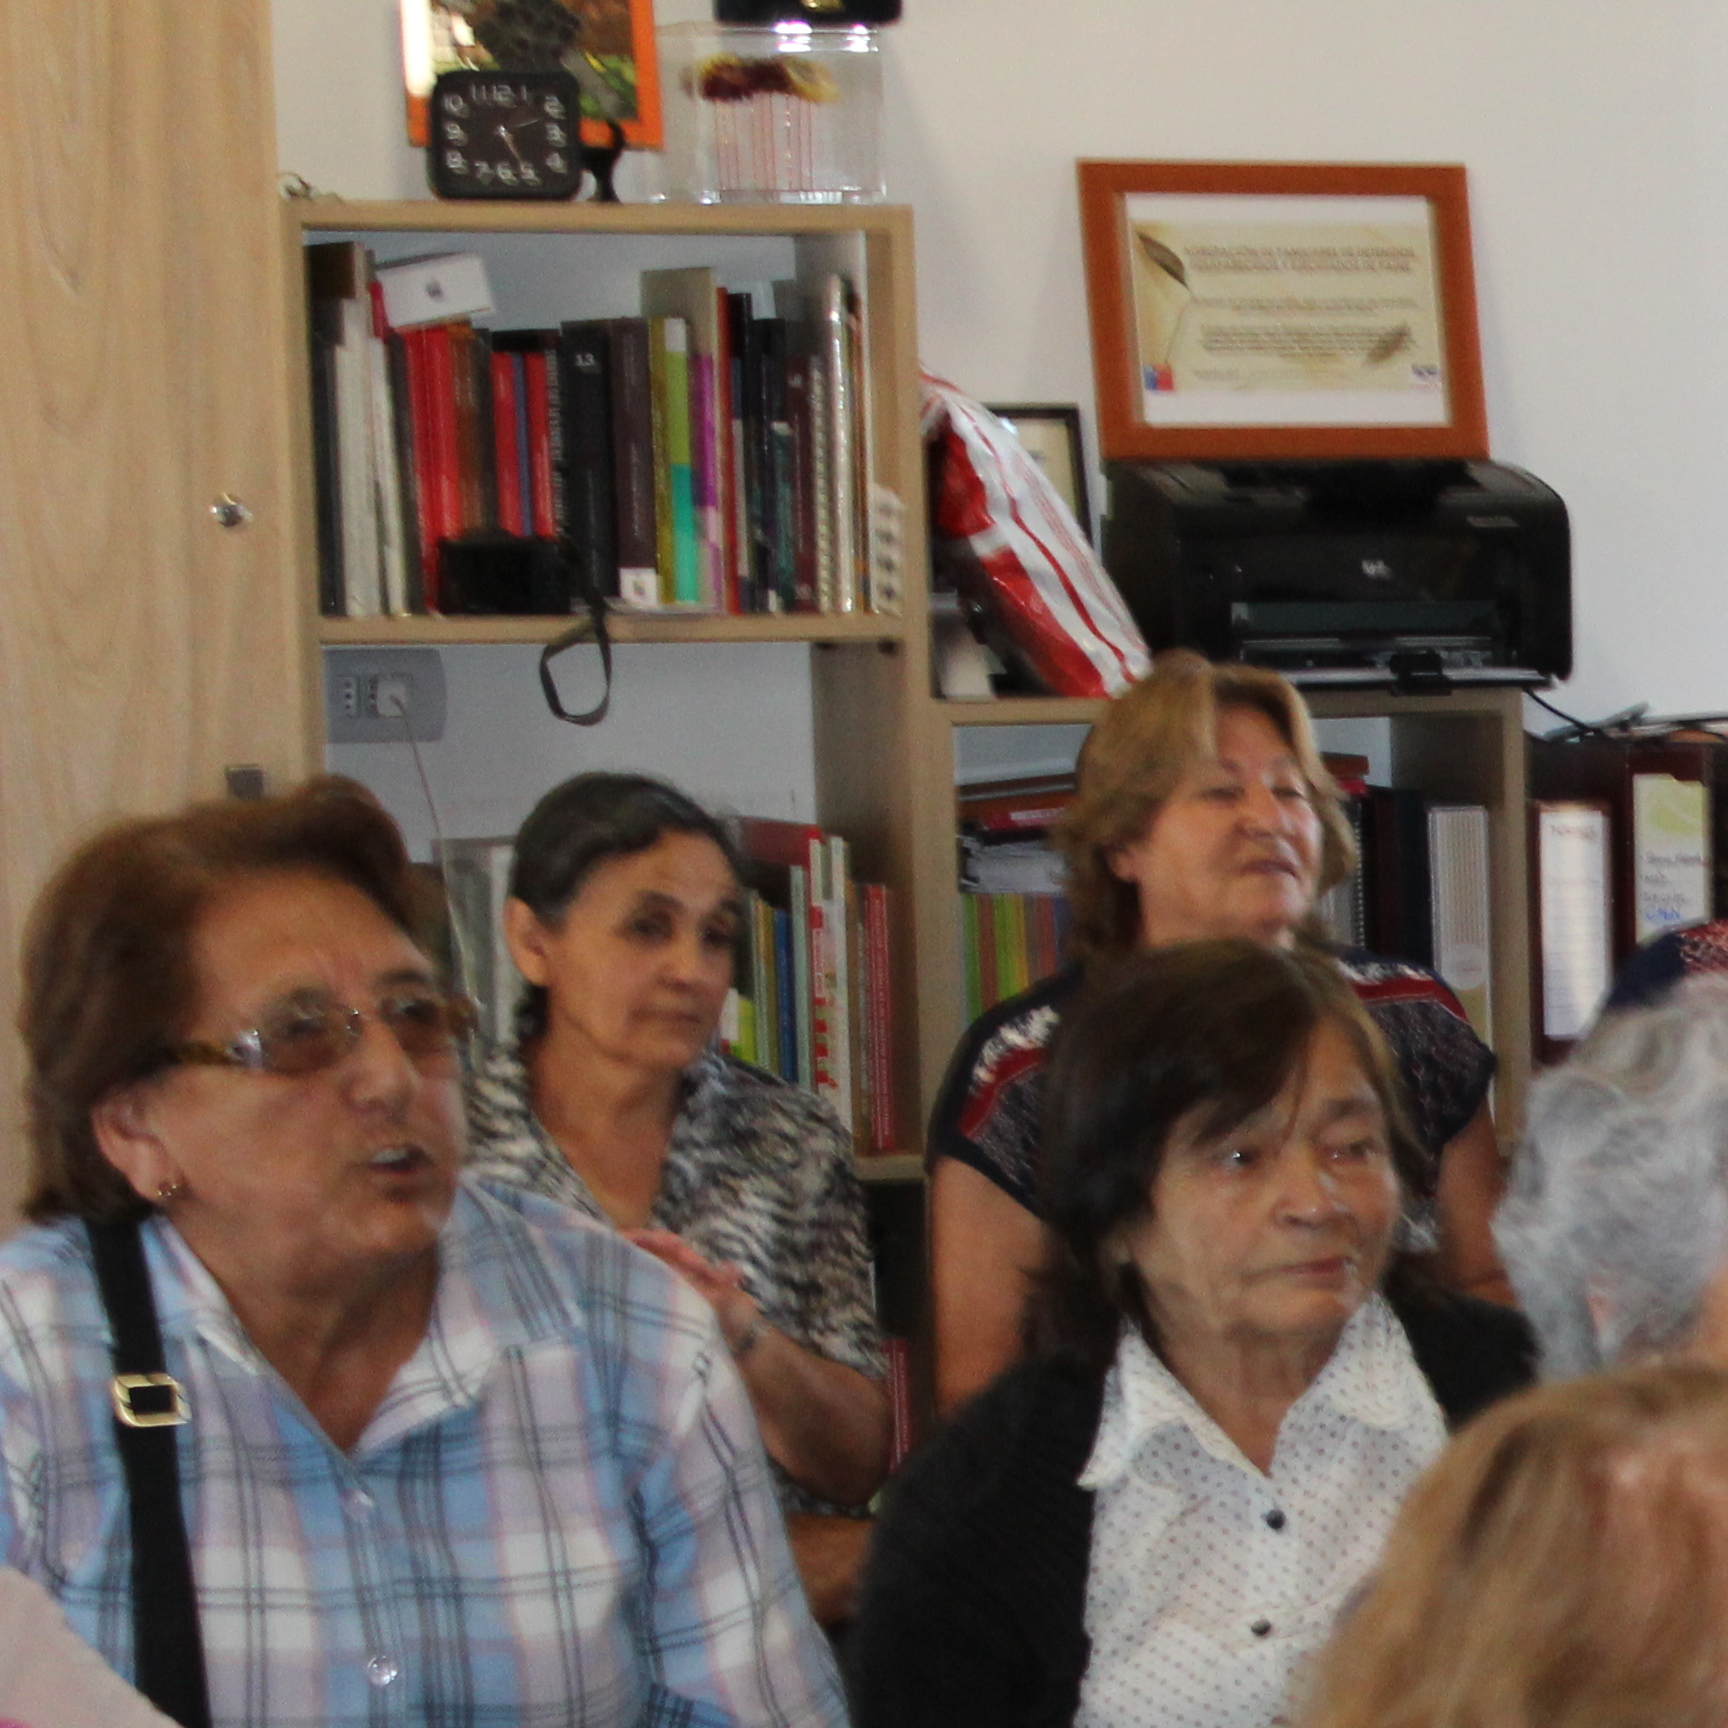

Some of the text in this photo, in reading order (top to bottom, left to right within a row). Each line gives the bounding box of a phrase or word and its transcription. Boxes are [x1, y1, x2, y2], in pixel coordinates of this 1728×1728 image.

[444, 94, 463, 112] 10
[492, 84, 513, 104] 12
[544, 95, 563, 116] 2
[444, 121, 461, 141] 9
[546, 122, 564, 144] 3
[497, 162, 514, 180] 6
